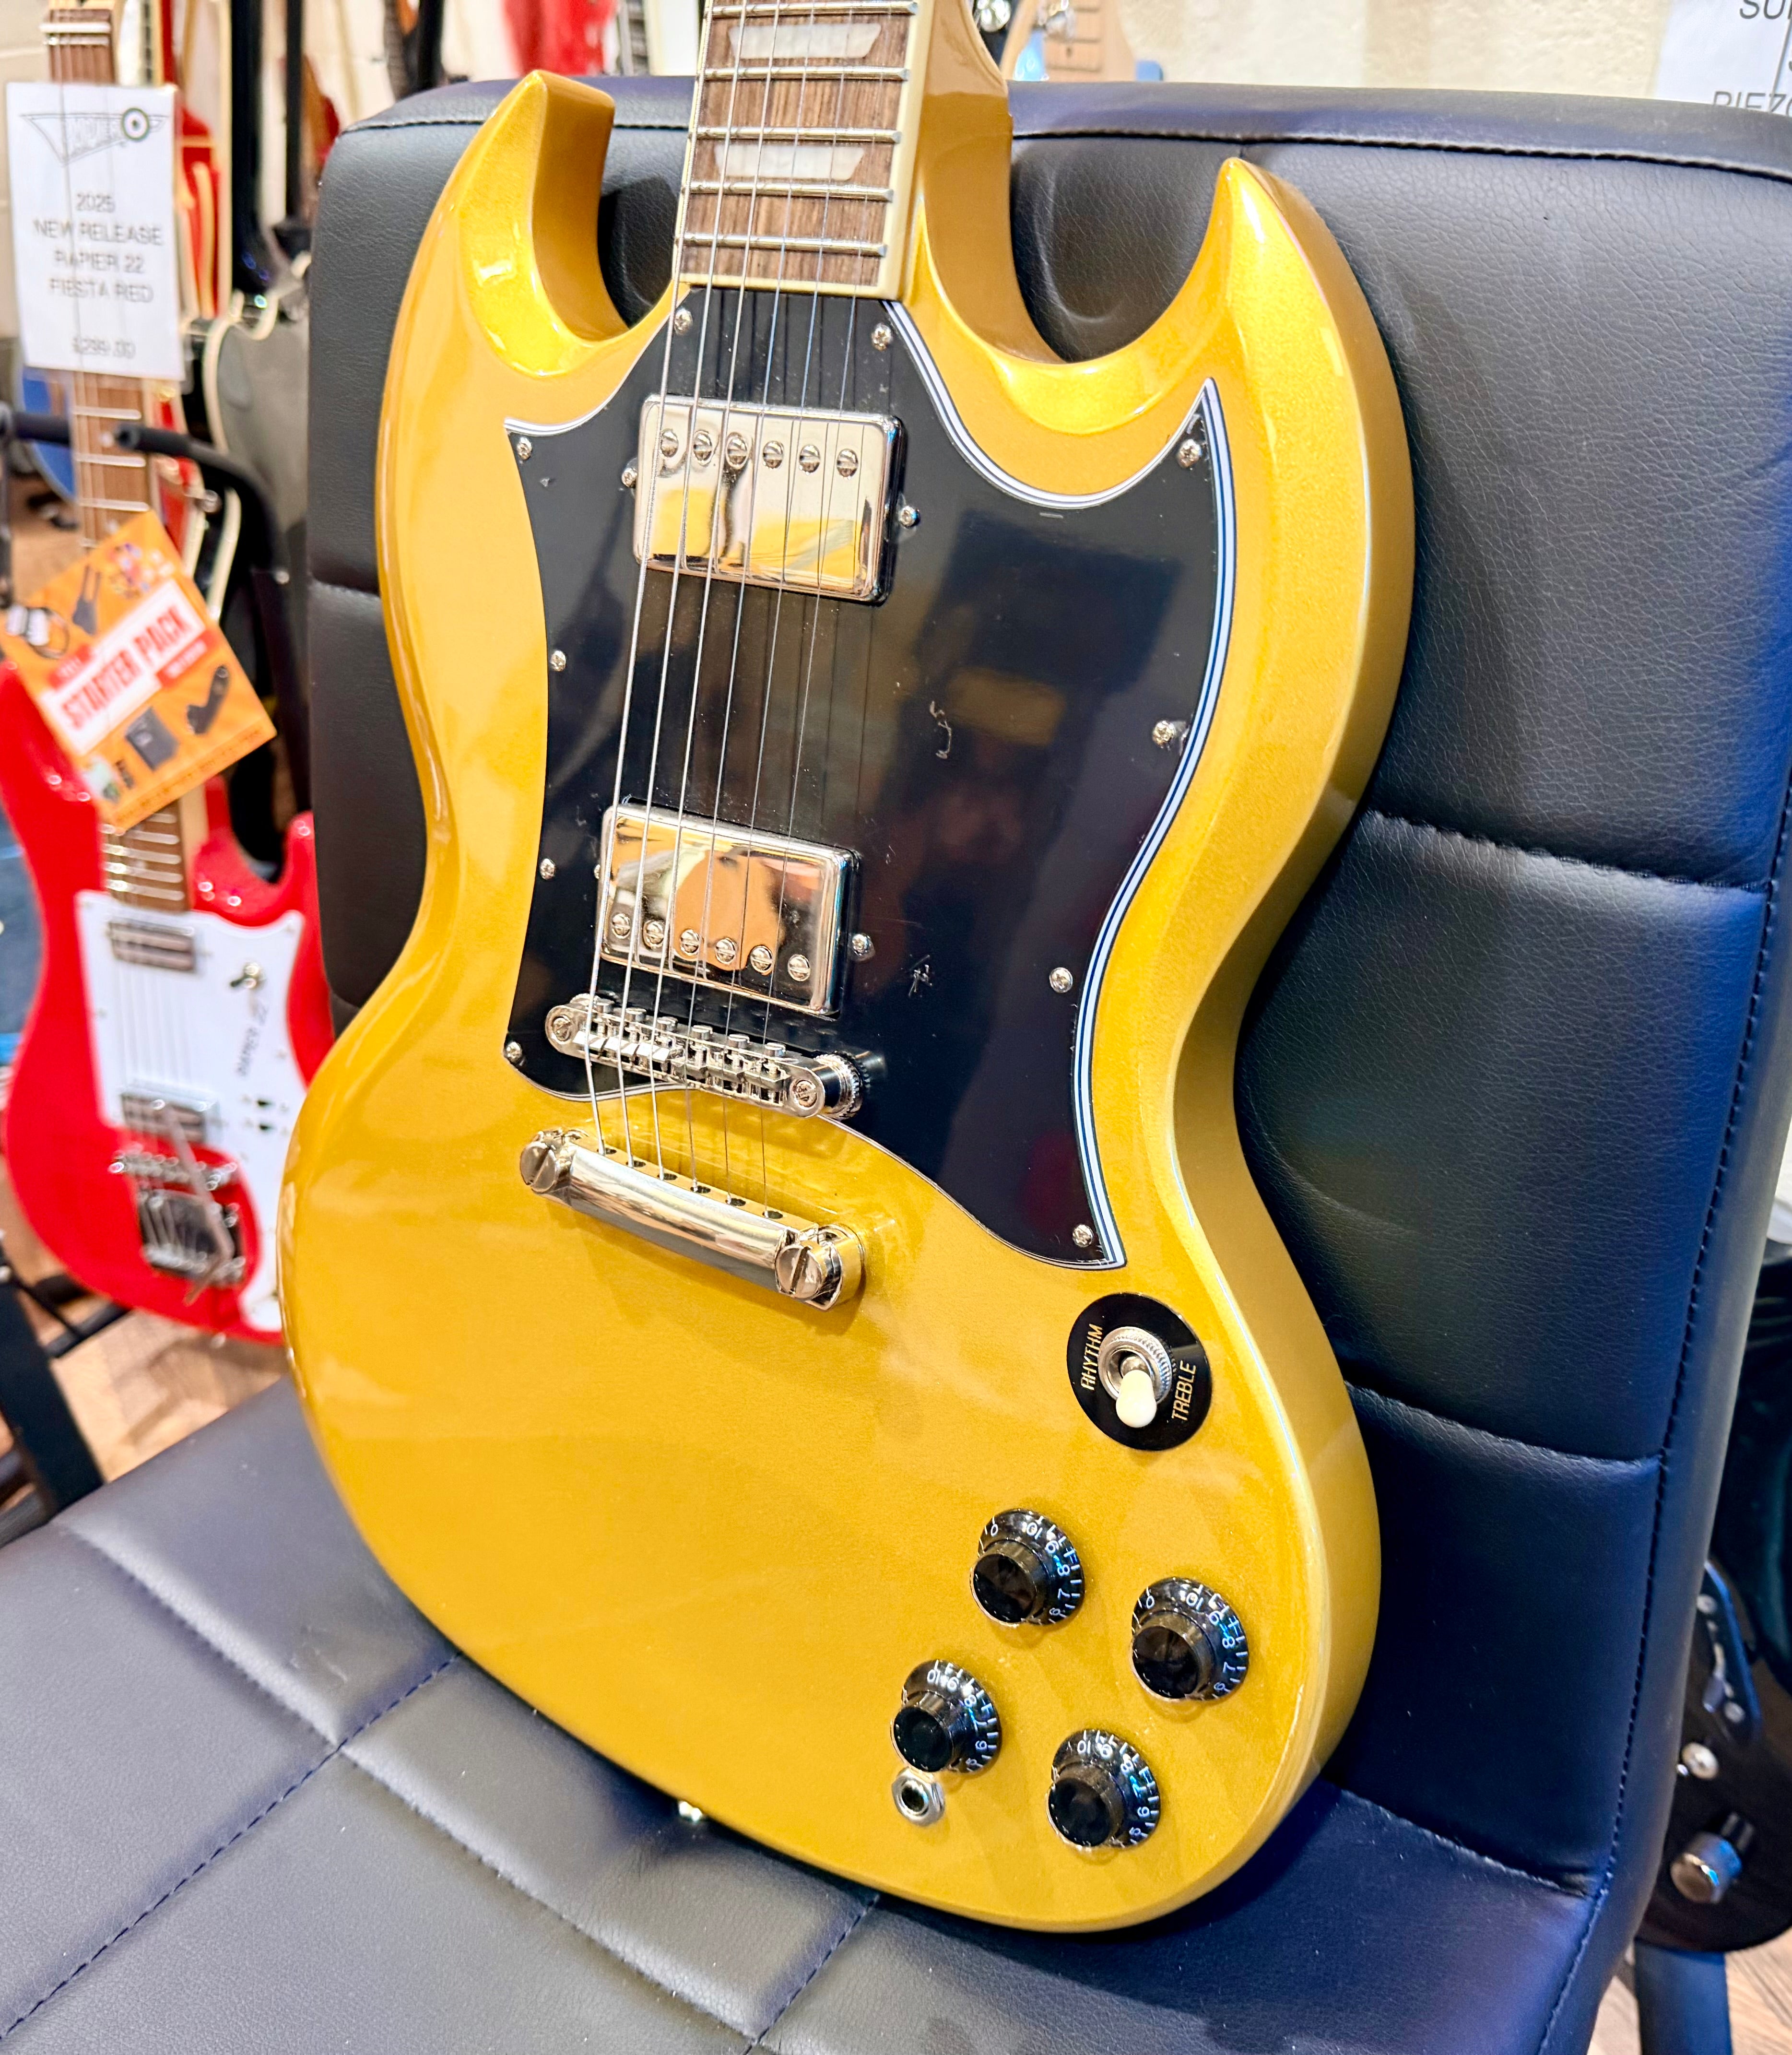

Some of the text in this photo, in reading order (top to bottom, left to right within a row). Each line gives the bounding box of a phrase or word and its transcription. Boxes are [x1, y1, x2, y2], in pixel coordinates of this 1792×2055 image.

[1740, 0, 1792, 19] SU
[76, 193, 115, 213] 2025
[33, 219, 164, 246] NEW RELEASE
[125, 254, 145, 274] 22
[49, 278, 154, 303] FIESTA RED
[62, 651, 142, 729] STARTER
[133, 605, 191, 666] PACK
[1081, 1323, 1103, 1391] RHYTHM
[1171, 1359, 1196, 1421] TREBLE
